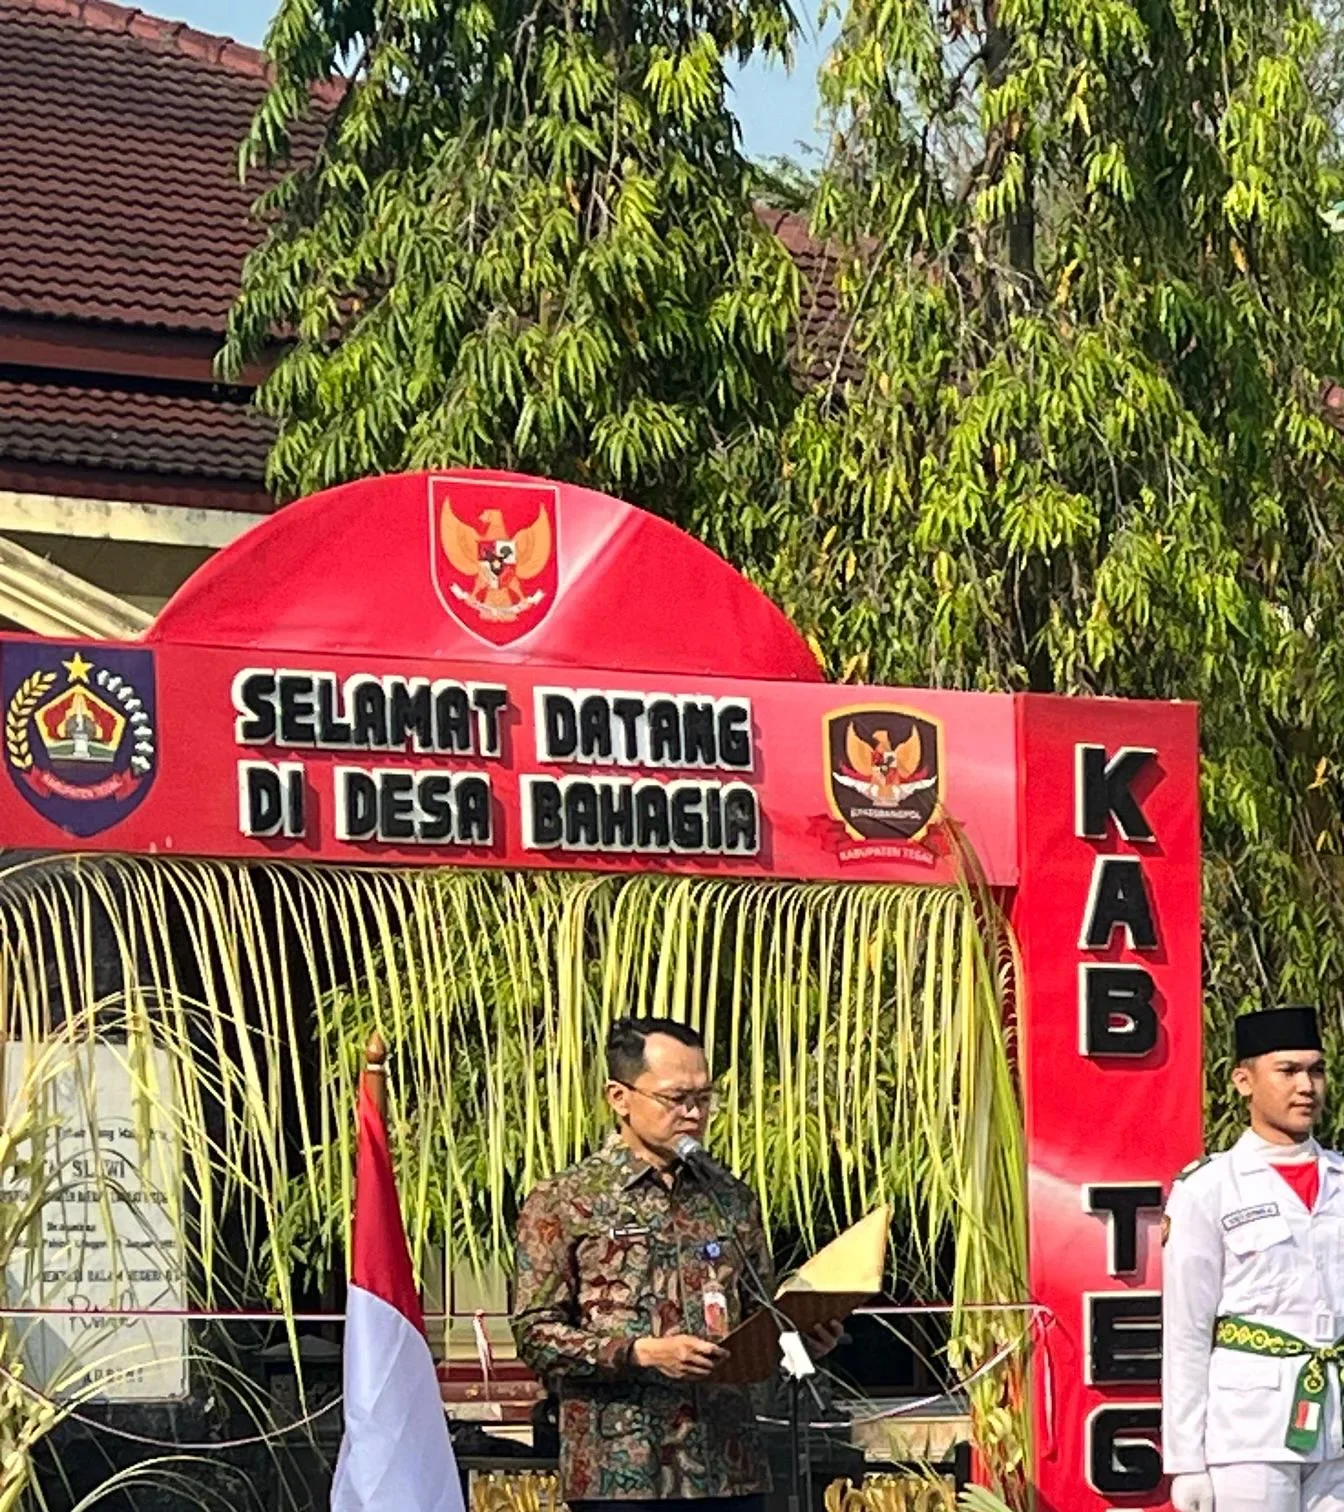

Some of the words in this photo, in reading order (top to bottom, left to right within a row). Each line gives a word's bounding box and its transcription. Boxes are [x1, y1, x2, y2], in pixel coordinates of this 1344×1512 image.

[232, 668, 507, 757] SELAMAT
[533, 686, 754, 772] DATANG
[237, 759, 305, 837] DI
[333, 766, 493, 846] DESA
[519, 773, 760, 856] BAHAGIA
[1075, 743, 1158, 1056] KAB
[72, 1158, 126, 1179] SLWI
